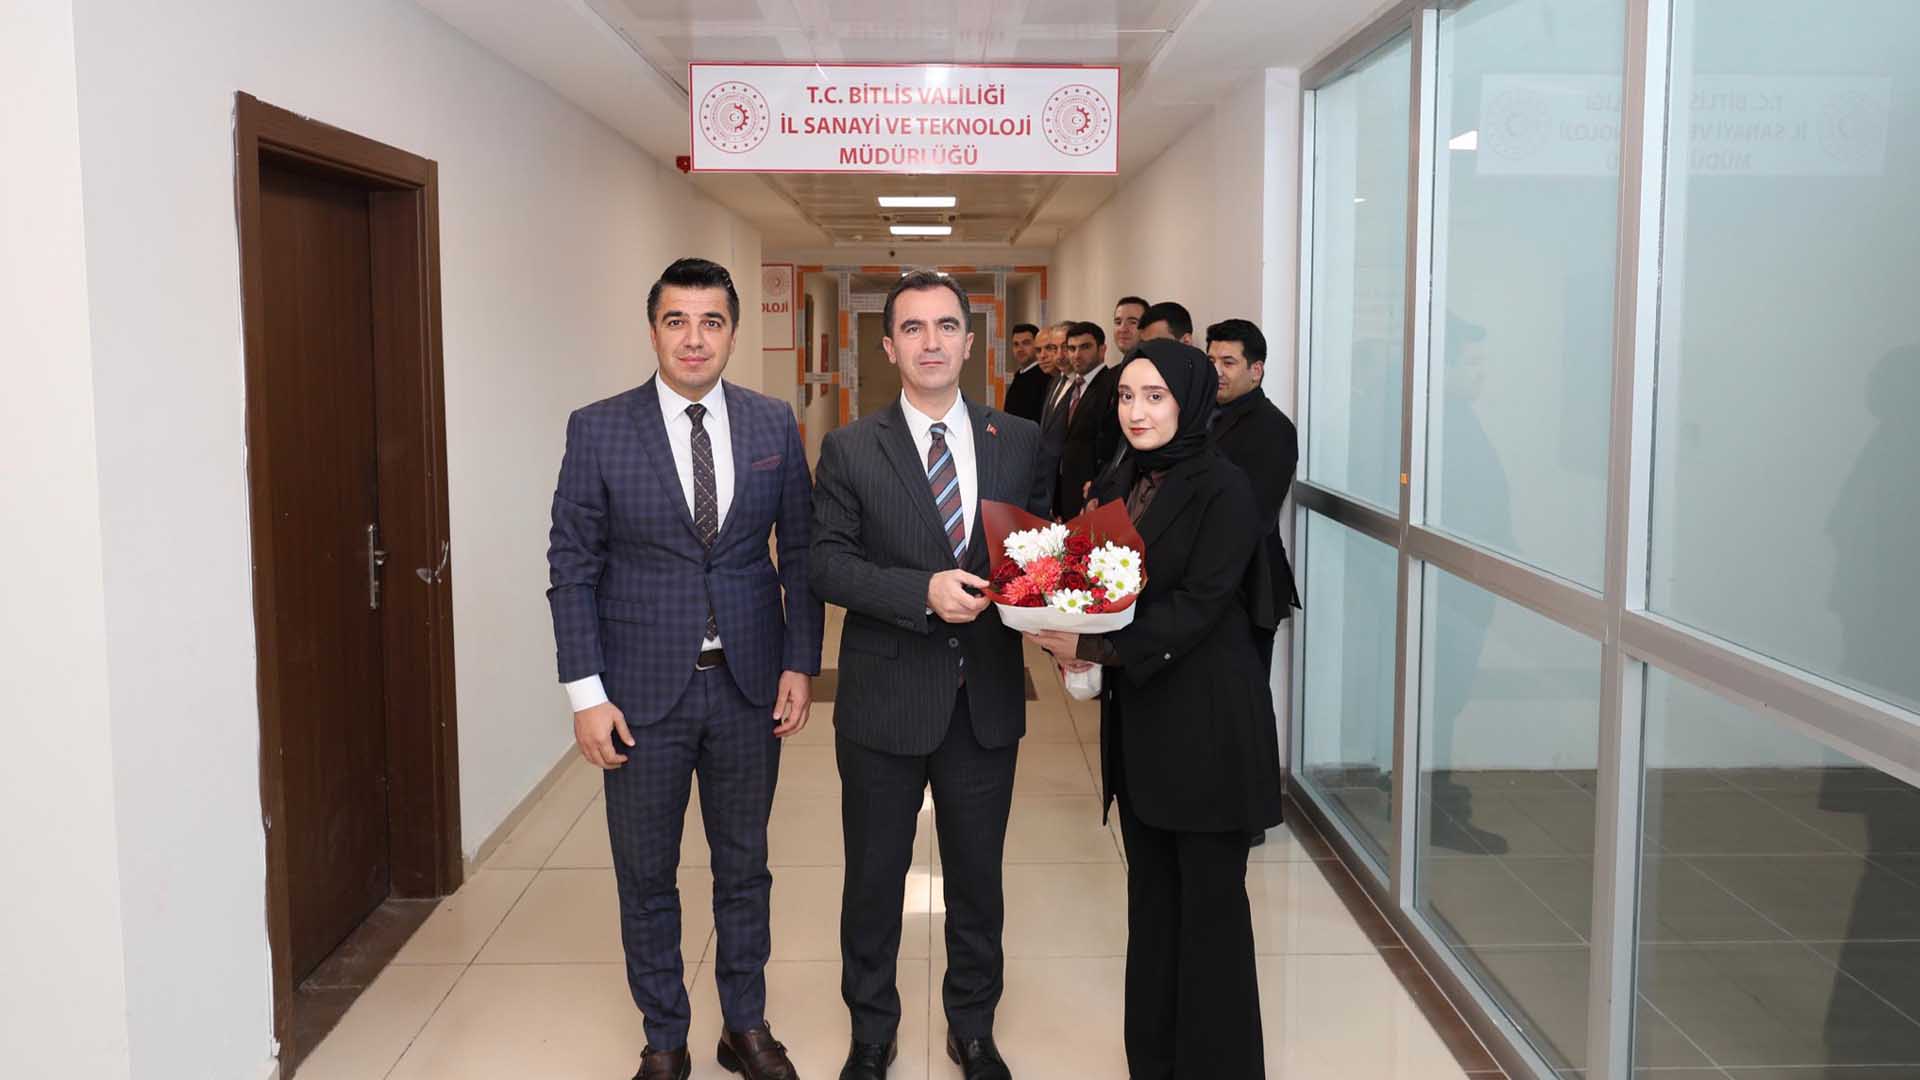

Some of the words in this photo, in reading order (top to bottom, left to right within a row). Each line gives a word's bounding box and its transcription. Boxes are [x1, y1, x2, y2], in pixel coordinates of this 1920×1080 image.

[807, 86, 843, 104] T.C.
[849, 83, 912, 105] BİTLİS
[918, 84, 1005, 105] VALİLİĞİ
[780, 112, 798, 134] İL
[804, 113, 880, 135] SANAYİ
[886, 117, 911, 135] VE
[916, 114, 1031, 136] TEKNOLOJİ
[839, 144, 978, 165] MÜDÜRLÜĞÜ
